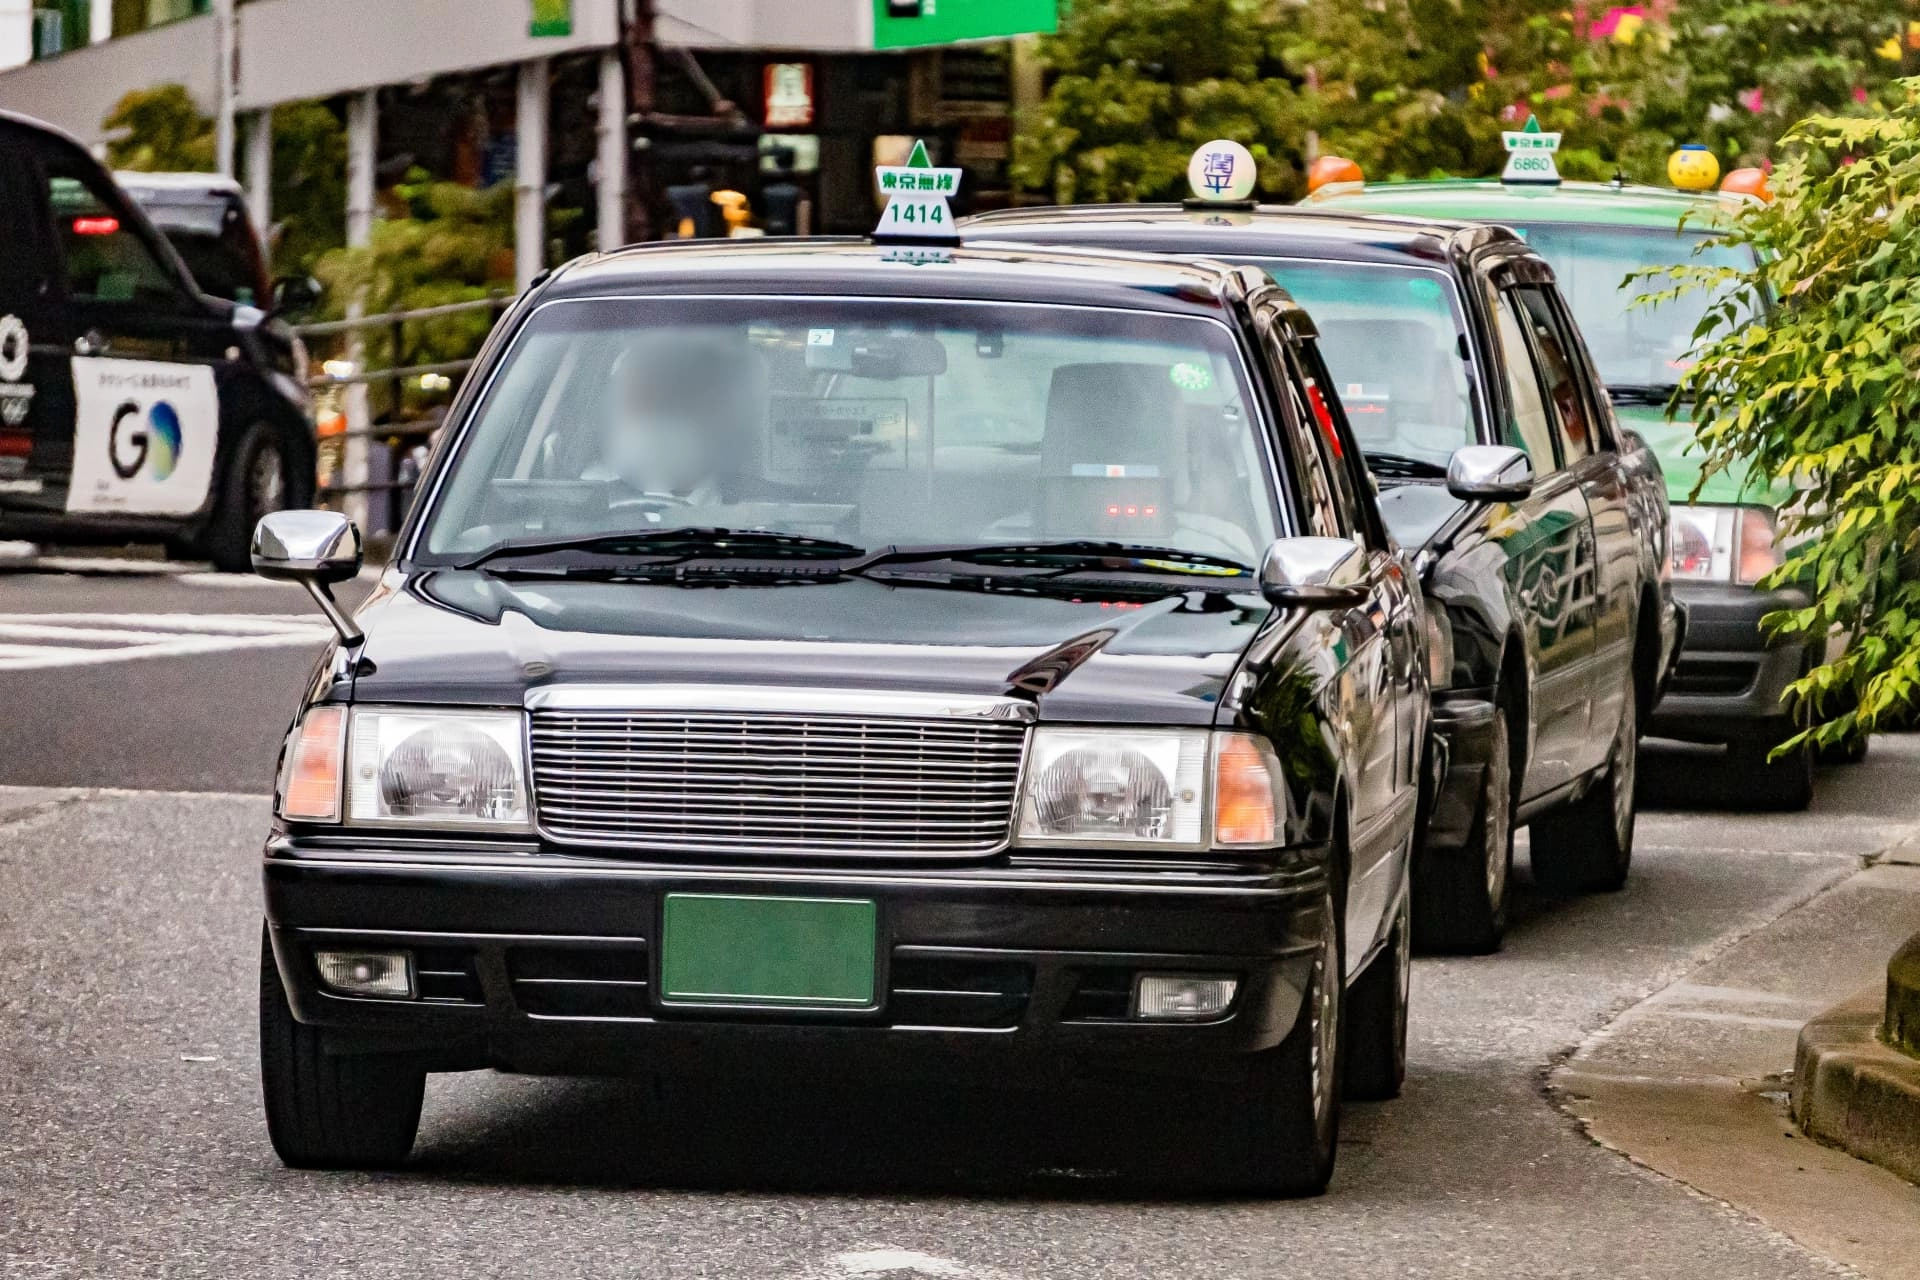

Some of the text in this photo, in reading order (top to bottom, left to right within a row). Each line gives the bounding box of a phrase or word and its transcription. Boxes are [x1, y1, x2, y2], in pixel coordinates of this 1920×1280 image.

[1513, 157, 1550, 171] 6860
[882, 171, 954, 191] 東京無線
[891, 203, 943, 225] 1414
[109, 400, 182, 482] GO
